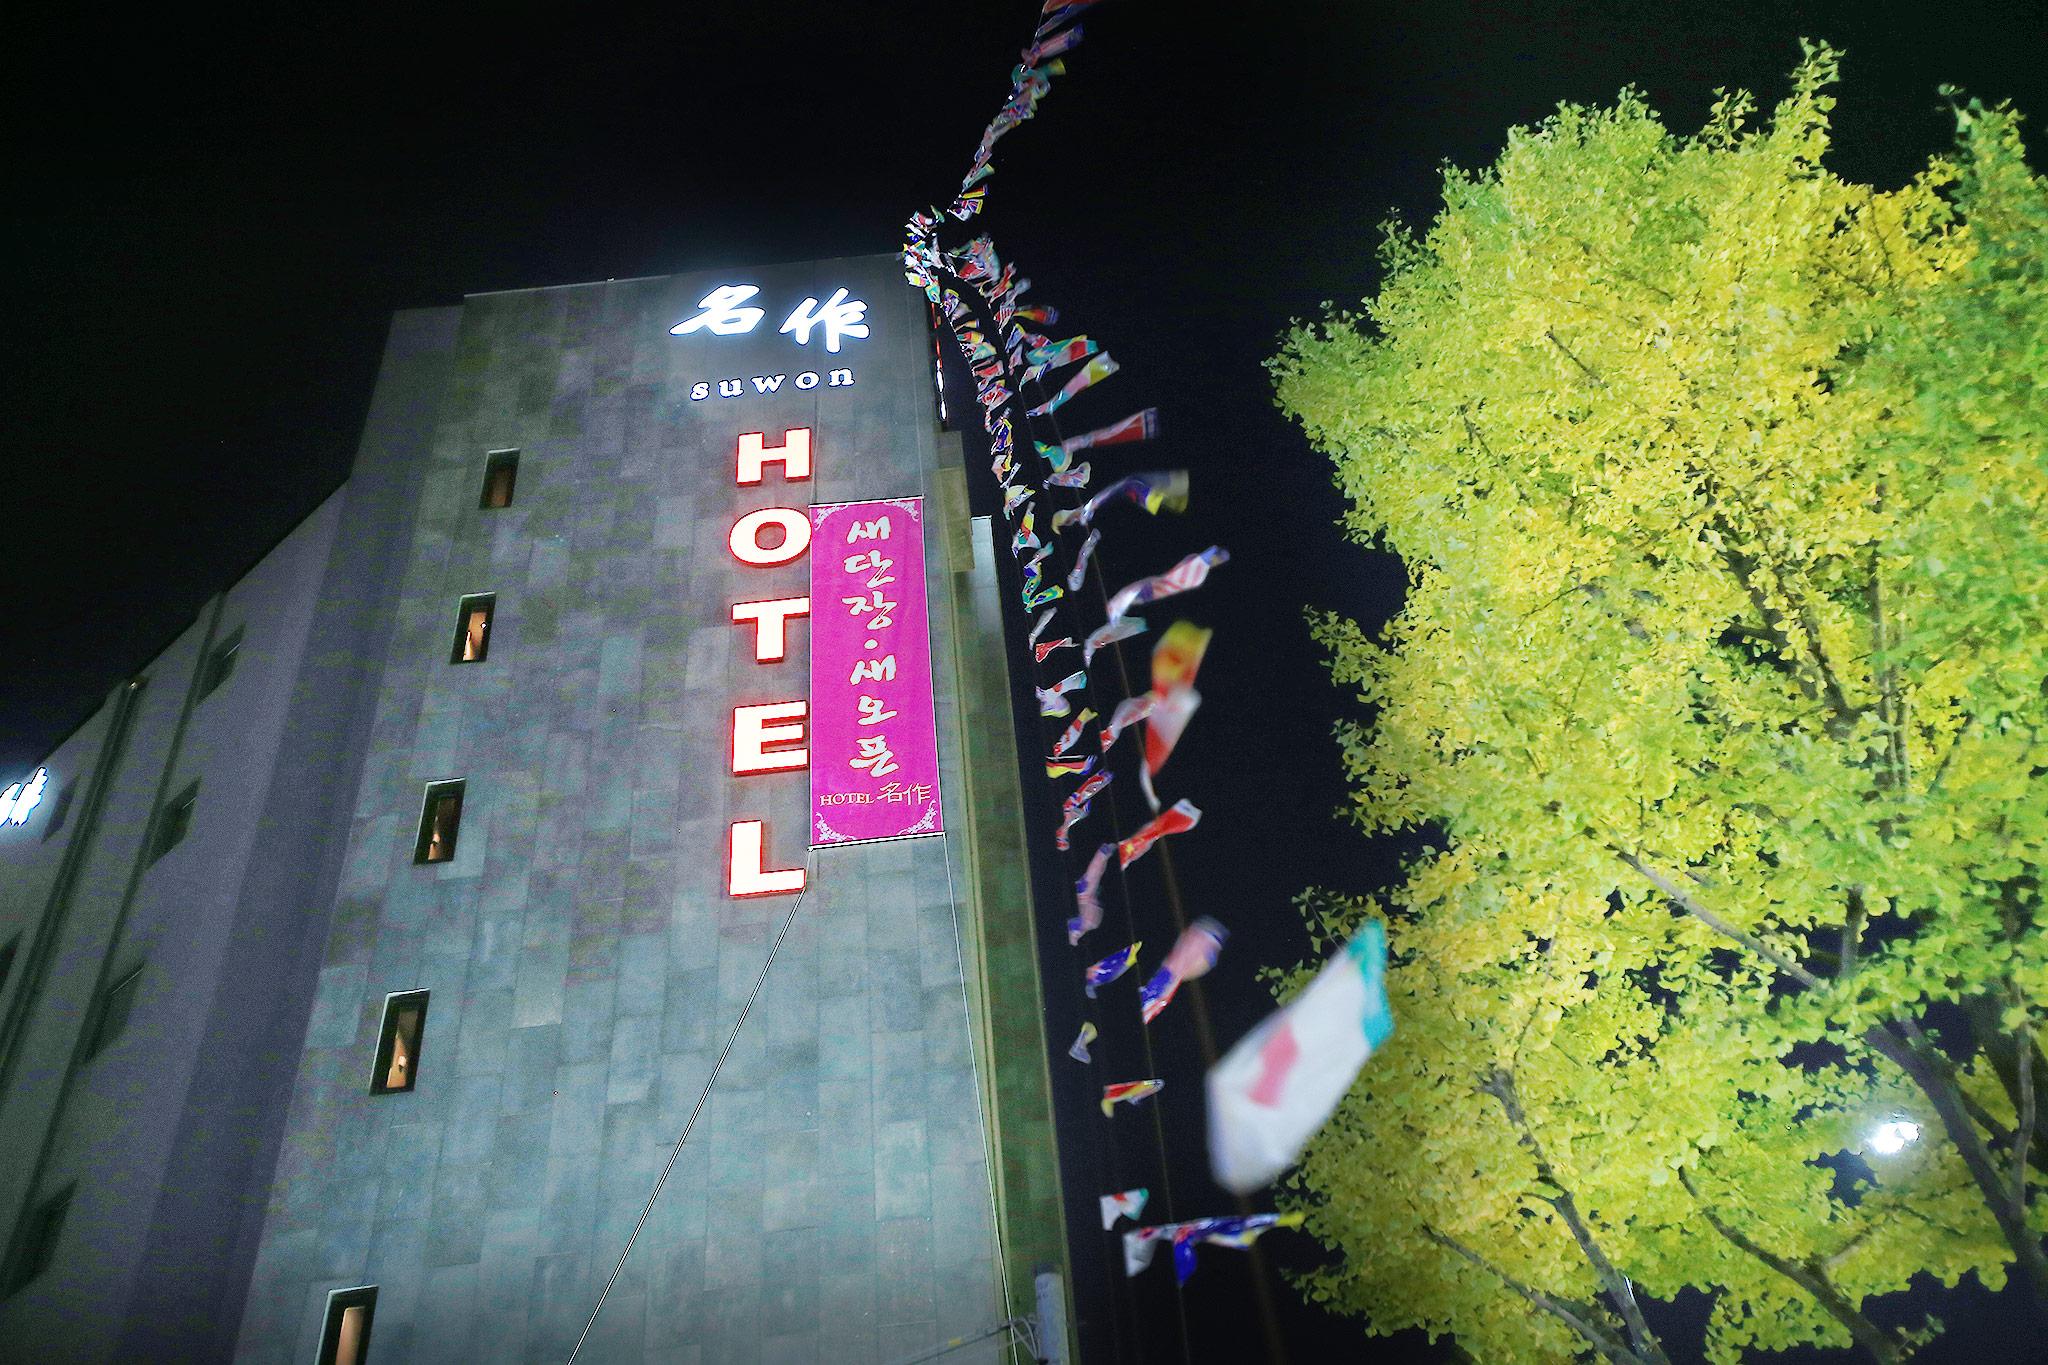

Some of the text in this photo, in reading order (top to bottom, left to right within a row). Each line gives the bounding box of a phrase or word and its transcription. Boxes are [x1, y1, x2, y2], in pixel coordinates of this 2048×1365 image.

[669, 283, 870, 353] 名作
[690, 367, 854, 401] suwon
[728, 427, 812, 897] HOTEL
[820, 782, 932, 806] HOTEL 名作
